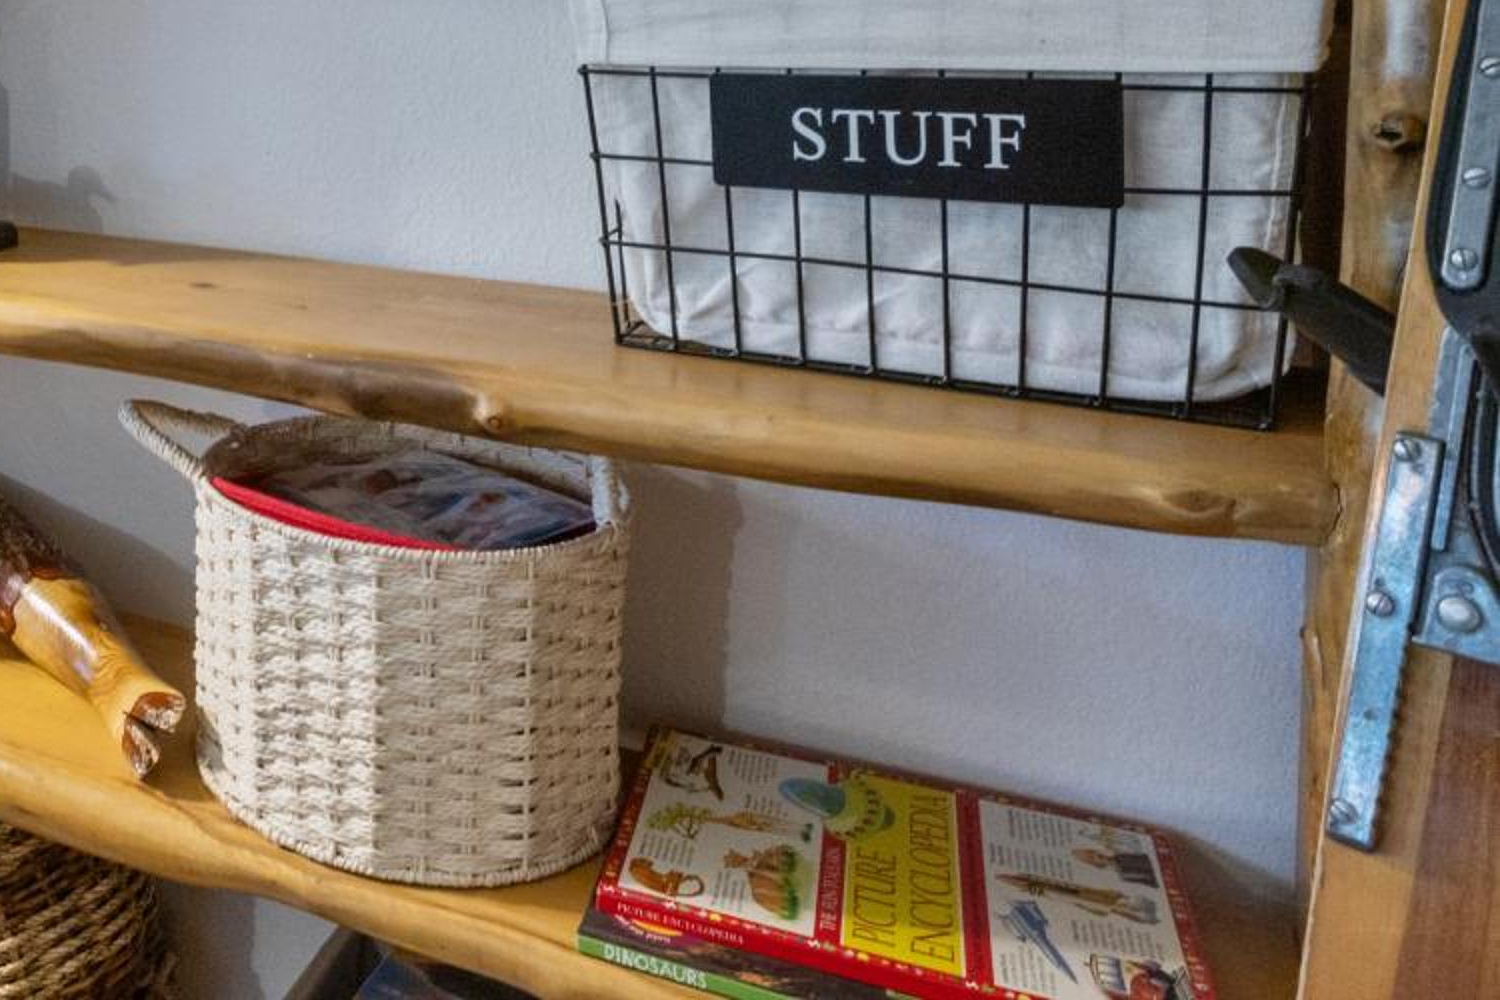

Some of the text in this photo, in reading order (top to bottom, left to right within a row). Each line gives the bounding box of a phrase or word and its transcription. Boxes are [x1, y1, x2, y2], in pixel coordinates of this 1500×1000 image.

[791, 107, 1026, 169] STUFF
[852, 847, 897, 947] PICTURE
[909, 794, 956, 963] ENCYCLOPEDIA
[603, 943, 708, 989] DINOSAURS
